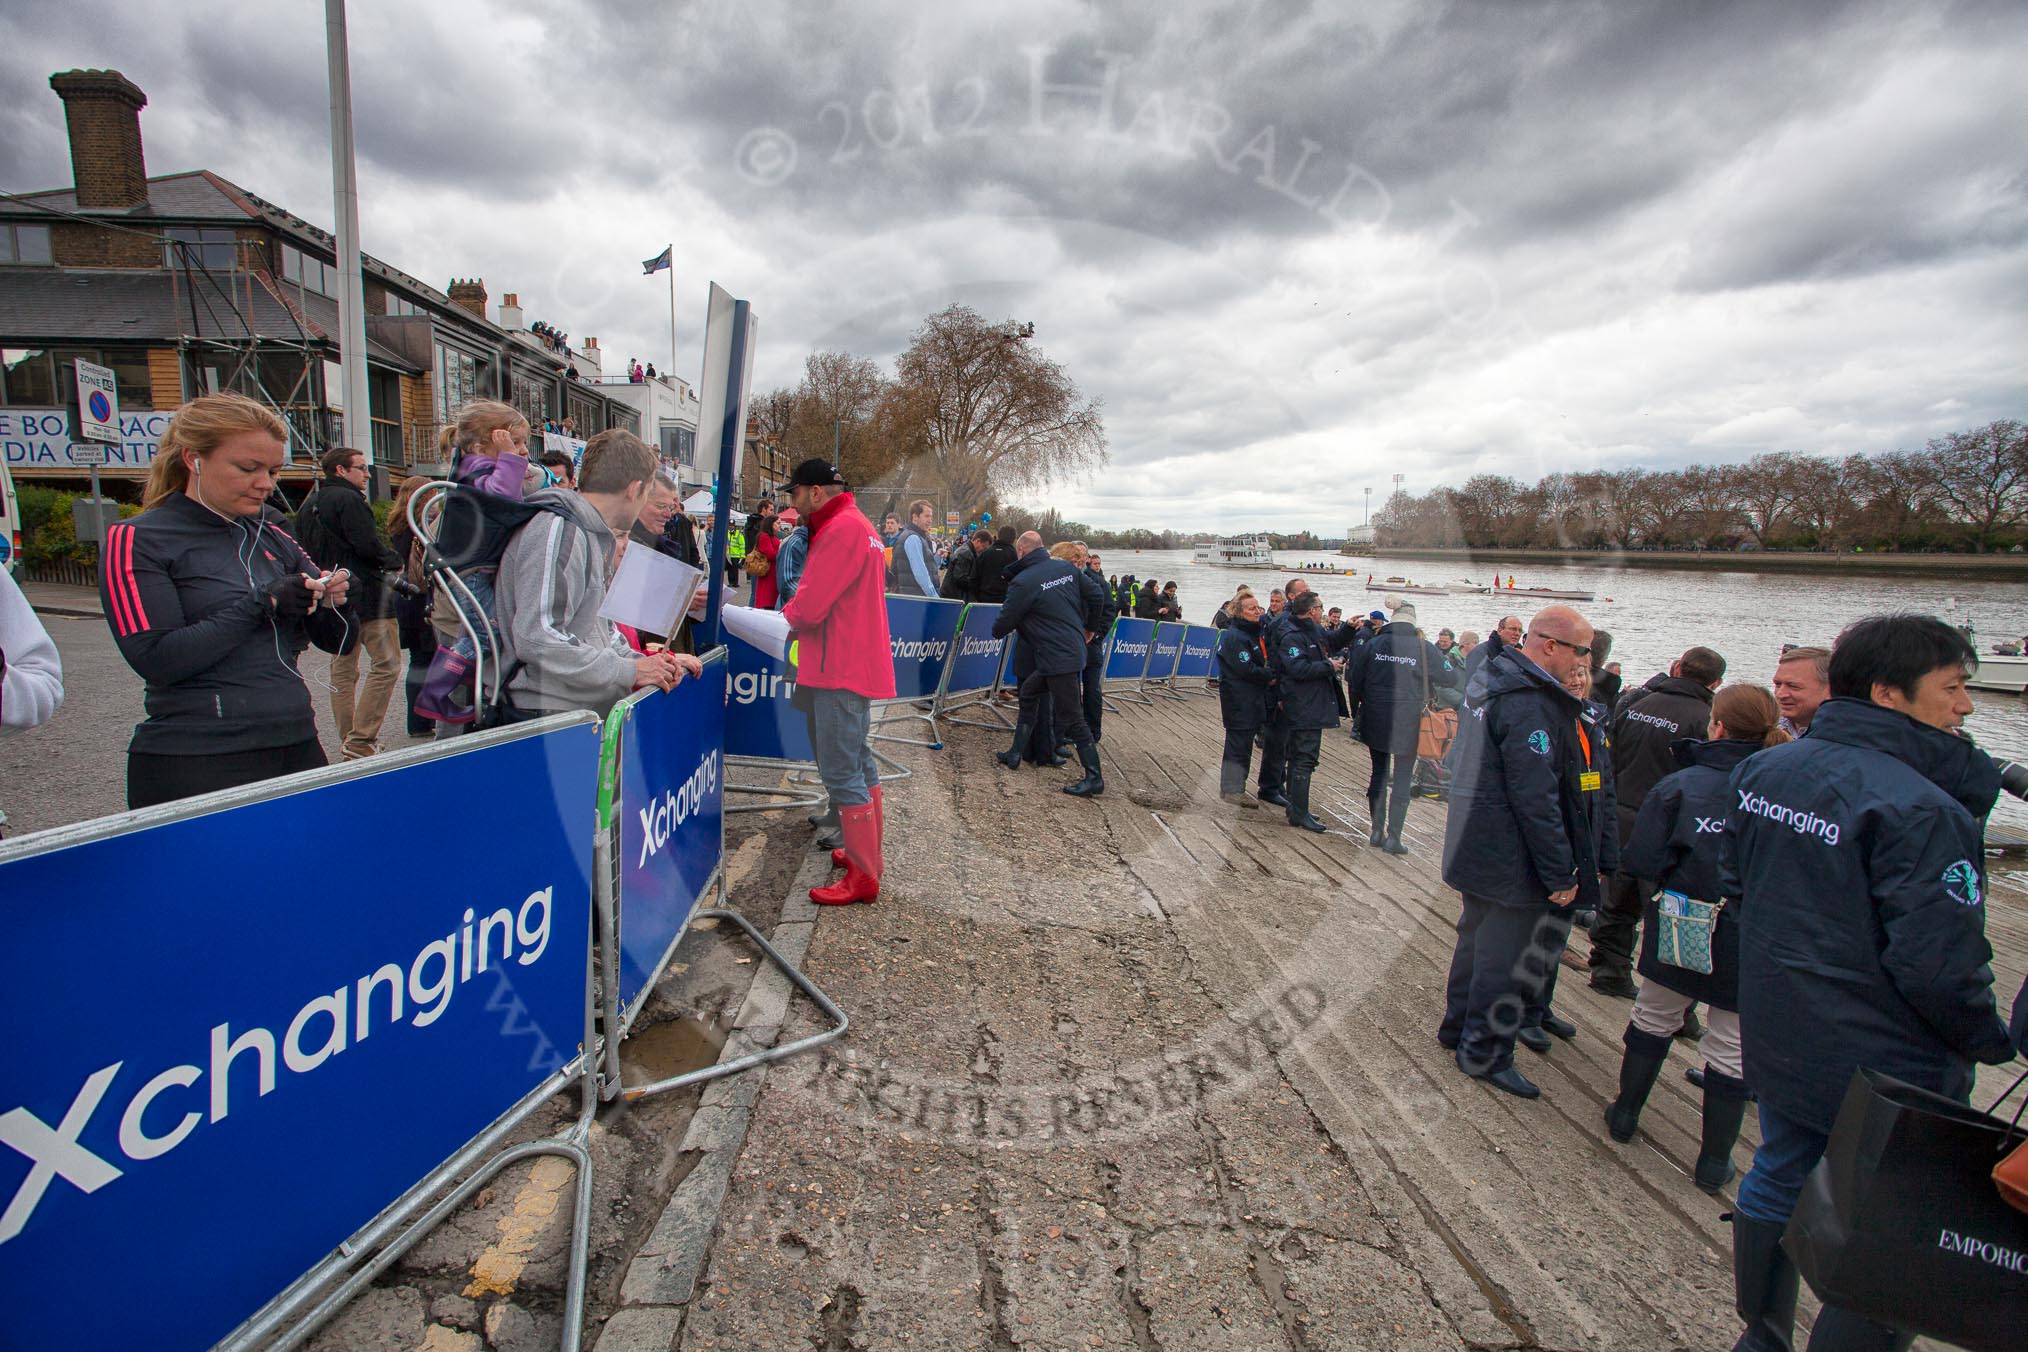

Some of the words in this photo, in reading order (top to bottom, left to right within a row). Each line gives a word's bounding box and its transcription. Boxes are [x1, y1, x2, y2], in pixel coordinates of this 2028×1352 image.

[80, 373, 101, 388] ZONE
[22, 415, 69, 436] BO
[1040, 574, 1074, 591] Xchanging
[890, 636, 948, 662] changing
[960, 636, 1003, 657] Xchanging
[1113, 639, 1148, 656] Xchanging
[1154, 642, 1177, 657] Xchanging
[1184, 644, 1211, 659] Xchanging
[1375, 653, 1417, 666] Xchanging
[1626, 709, 1679, 733] Xchanging
[638, 748, 718, 869] Xchanging
[1737, 789, 1840, 846] Xchanging
[0, 886, 553, 1245] Xchanging
